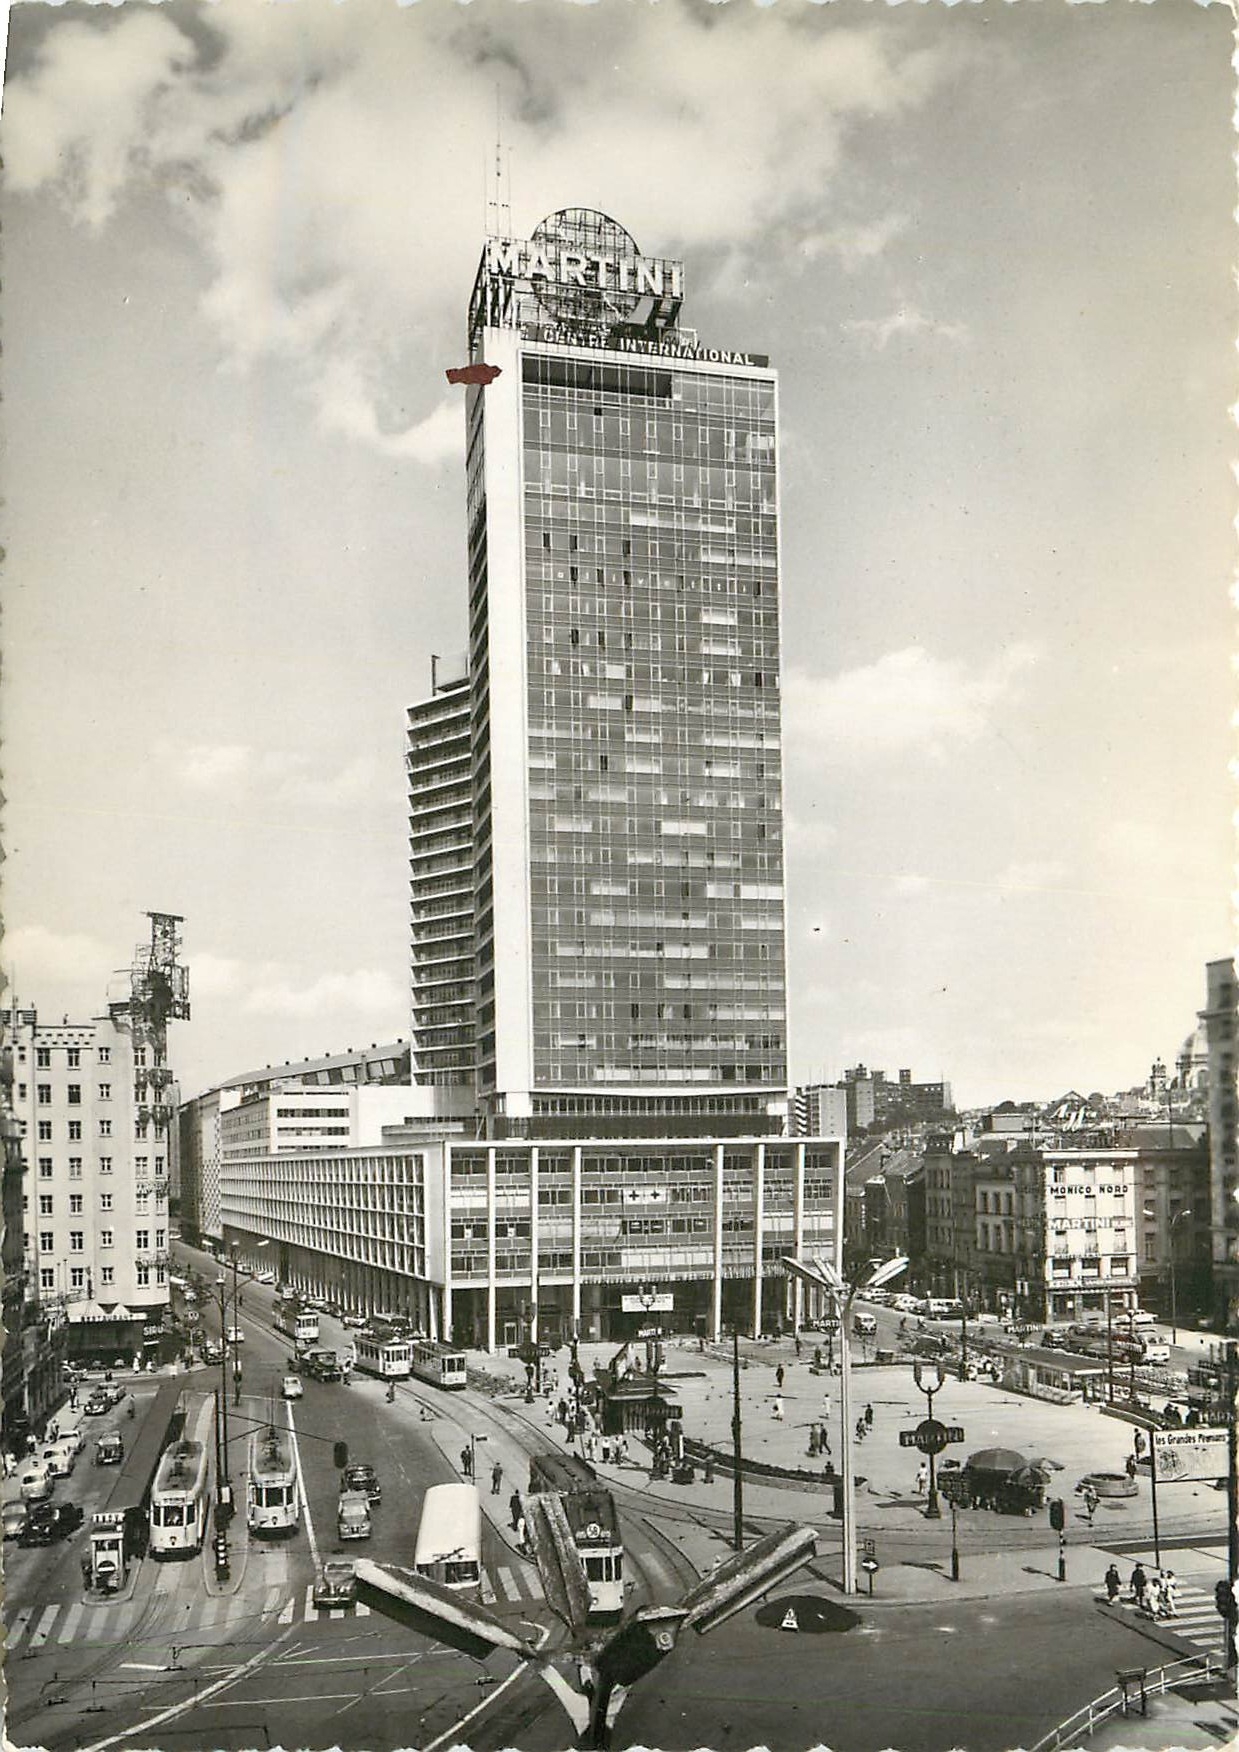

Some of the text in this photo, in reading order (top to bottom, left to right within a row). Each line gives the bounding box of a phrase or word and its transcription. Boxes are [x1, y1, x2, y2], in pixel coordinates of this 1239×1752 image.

[488, 239, 683, 298] MARTINI
[543, 328, 756, 366] CENTRE INTERNATIONAL
[1050, 1185, 1129, 1195] MONICO NORD
[1048, 1217, 1111, 1230] MARTINI
